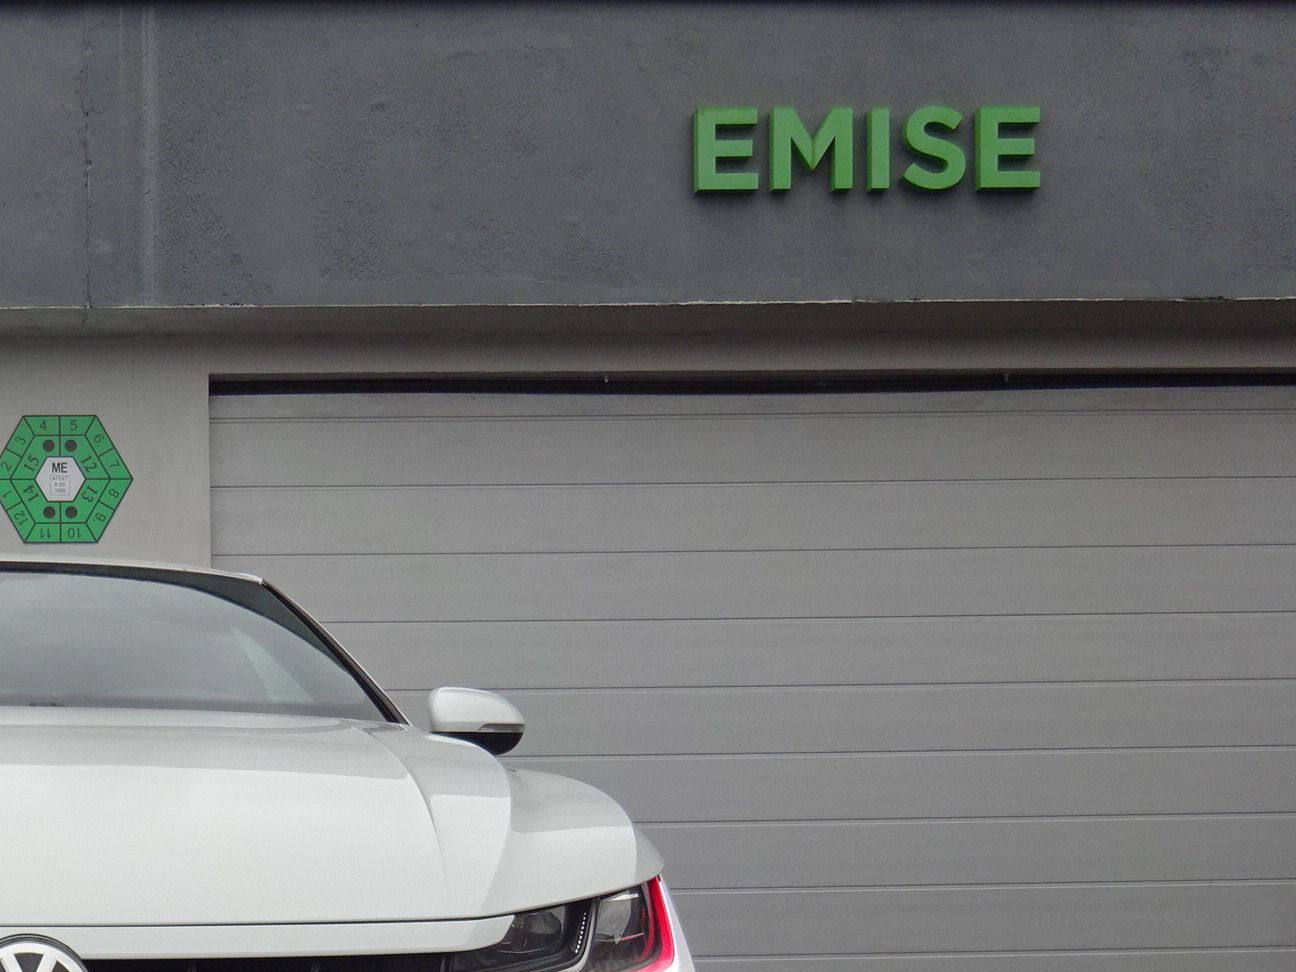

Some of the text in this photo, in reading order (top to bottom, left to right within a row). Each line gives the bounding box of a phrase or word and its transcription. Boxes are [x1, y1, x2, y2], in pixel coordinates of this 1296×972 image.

[692, 105, 1041, 192] EMISE
[39, 420, 47, 432] 4
[70, 420, 78, 431] 5
[14, 435, 26, 445] 3
[0, 462, 12, 472] 2
[23, 455, 39, 472] 15
[51, 462, 68, 473] ME
[81, 455, 98, 473] 12
[109, 461, 120, 469] 7
[22, 484, 39, 502] 14
[82, 485, 98, 503] 13
[108, 488, 120, 498] 8
[13, 510, 29, 526] 12
[39, 528, 51, 538] 11
[67, 527, 82, 538] 10
